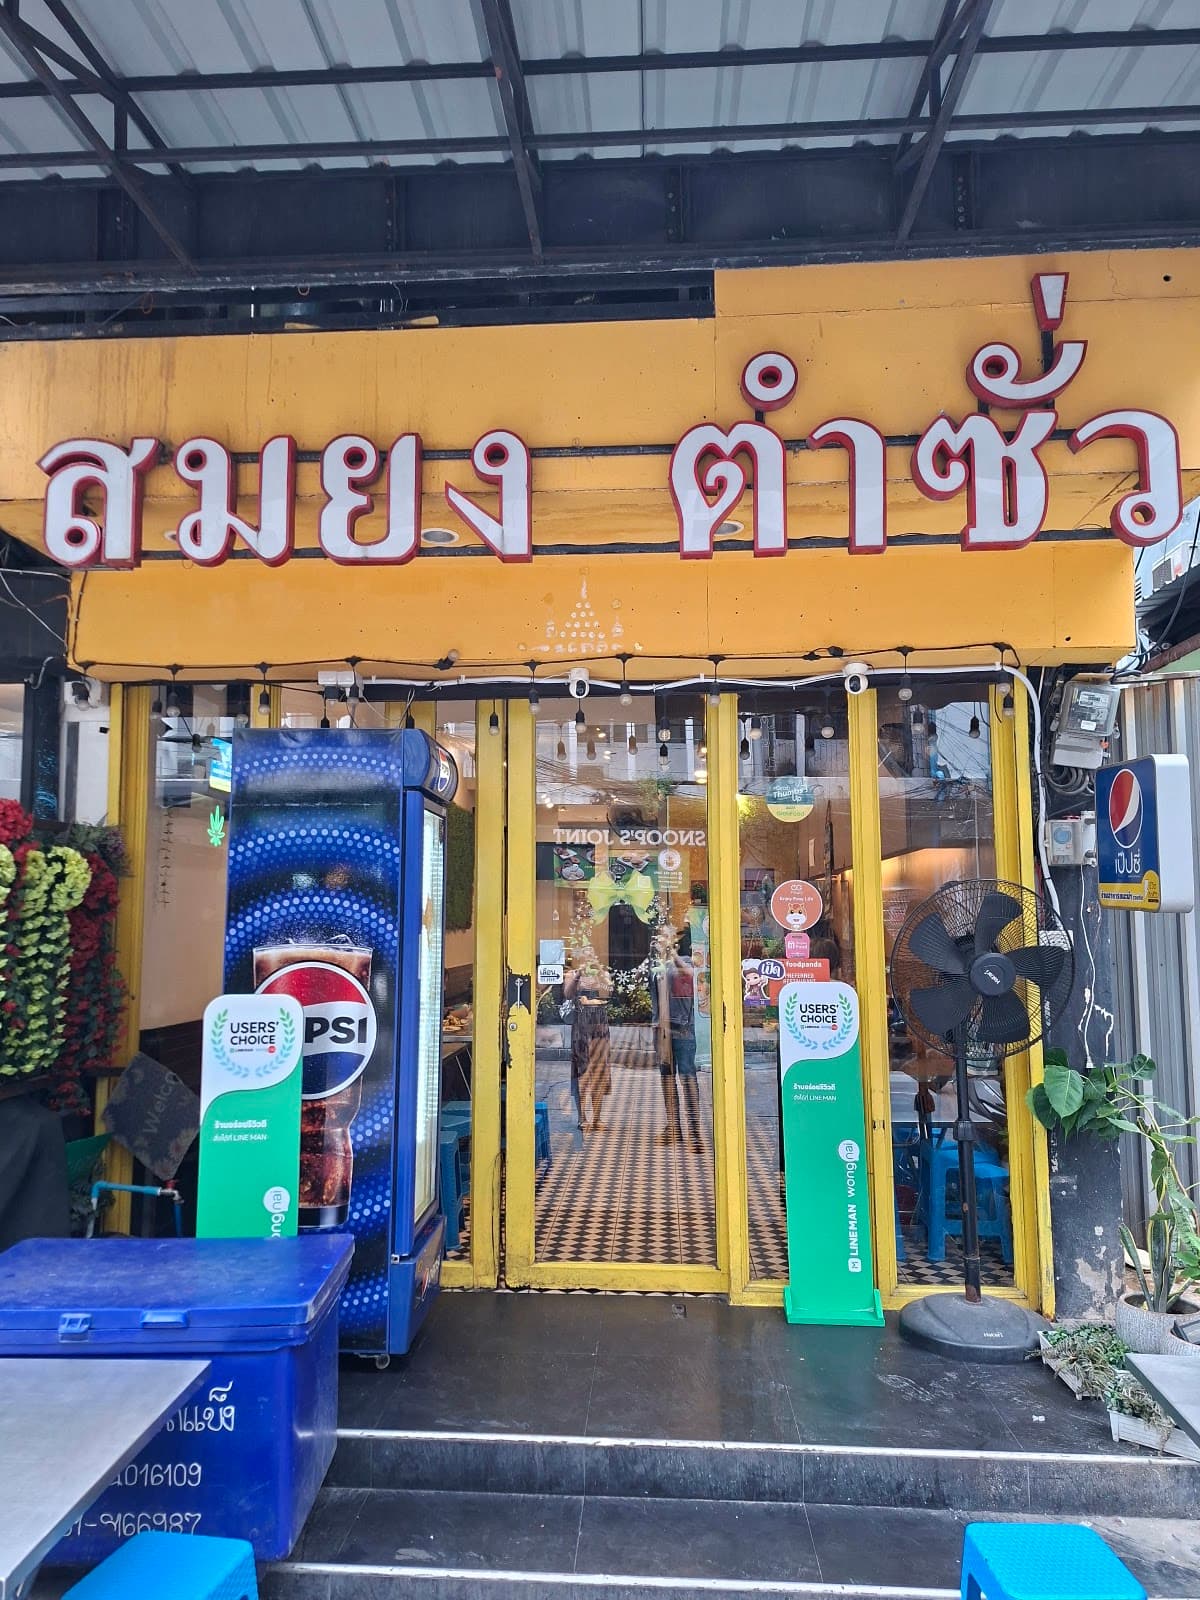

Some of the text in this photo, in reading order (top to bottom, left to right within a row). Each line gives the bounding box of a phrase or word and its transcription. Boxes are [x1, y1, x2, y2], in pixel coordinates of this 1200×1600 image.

[36, 272, 1183, 570] สมยง ตำซั่ว
[761, 961, 781, 977] เปิด
[799, 1003, 839, 1014] USERS'
[800, 1015, 838, 1024] CHOICE
[230, 1021, 279, 1034] USERS'
[304, 1016, 368, 1045] PSI
[230, 1035, 276, 1046] CHOICE
[842, 1142, 859, 1256] LINEMAN wongnai
